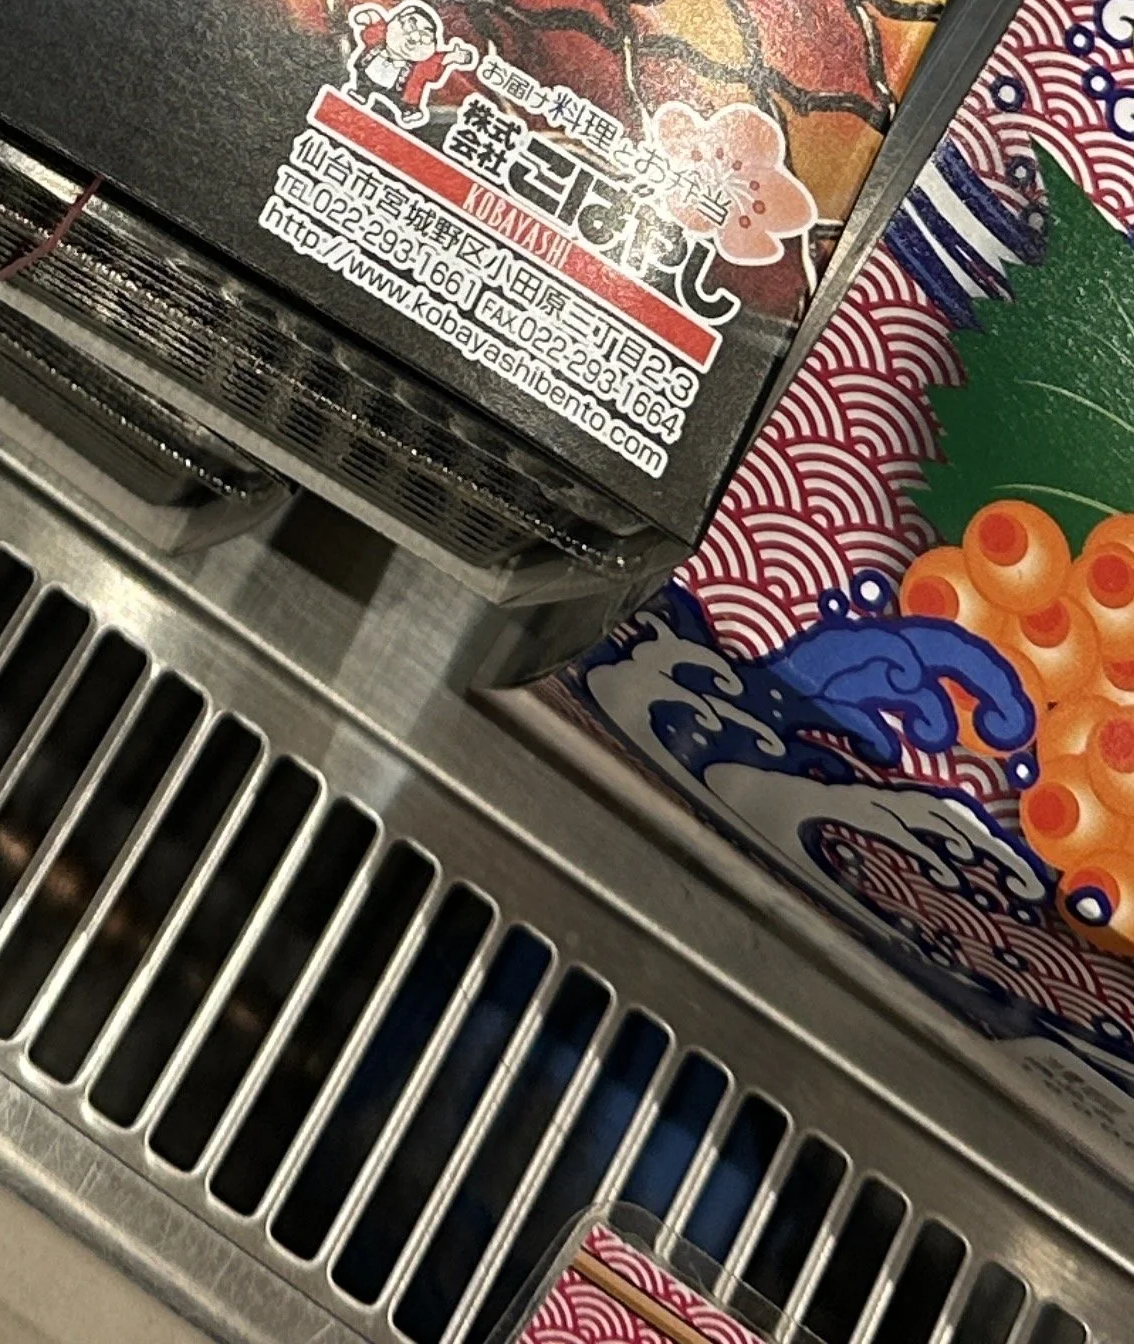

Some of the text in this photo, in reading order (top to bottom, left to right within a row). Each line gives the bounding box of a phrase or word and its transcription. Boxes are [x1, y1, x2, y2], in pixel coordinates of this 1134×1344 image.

[463, 181, 577, 269] KOBAYASHI
[481, 58, 730, 225] お届け料理とお弁当
[507, 139, 741, 318] こばやし
[265, 202, 665, 471] http://www.kobayashibento.com
[296, 136, 697, 399] 仙台市宮城野区小田原三丁目2-3
